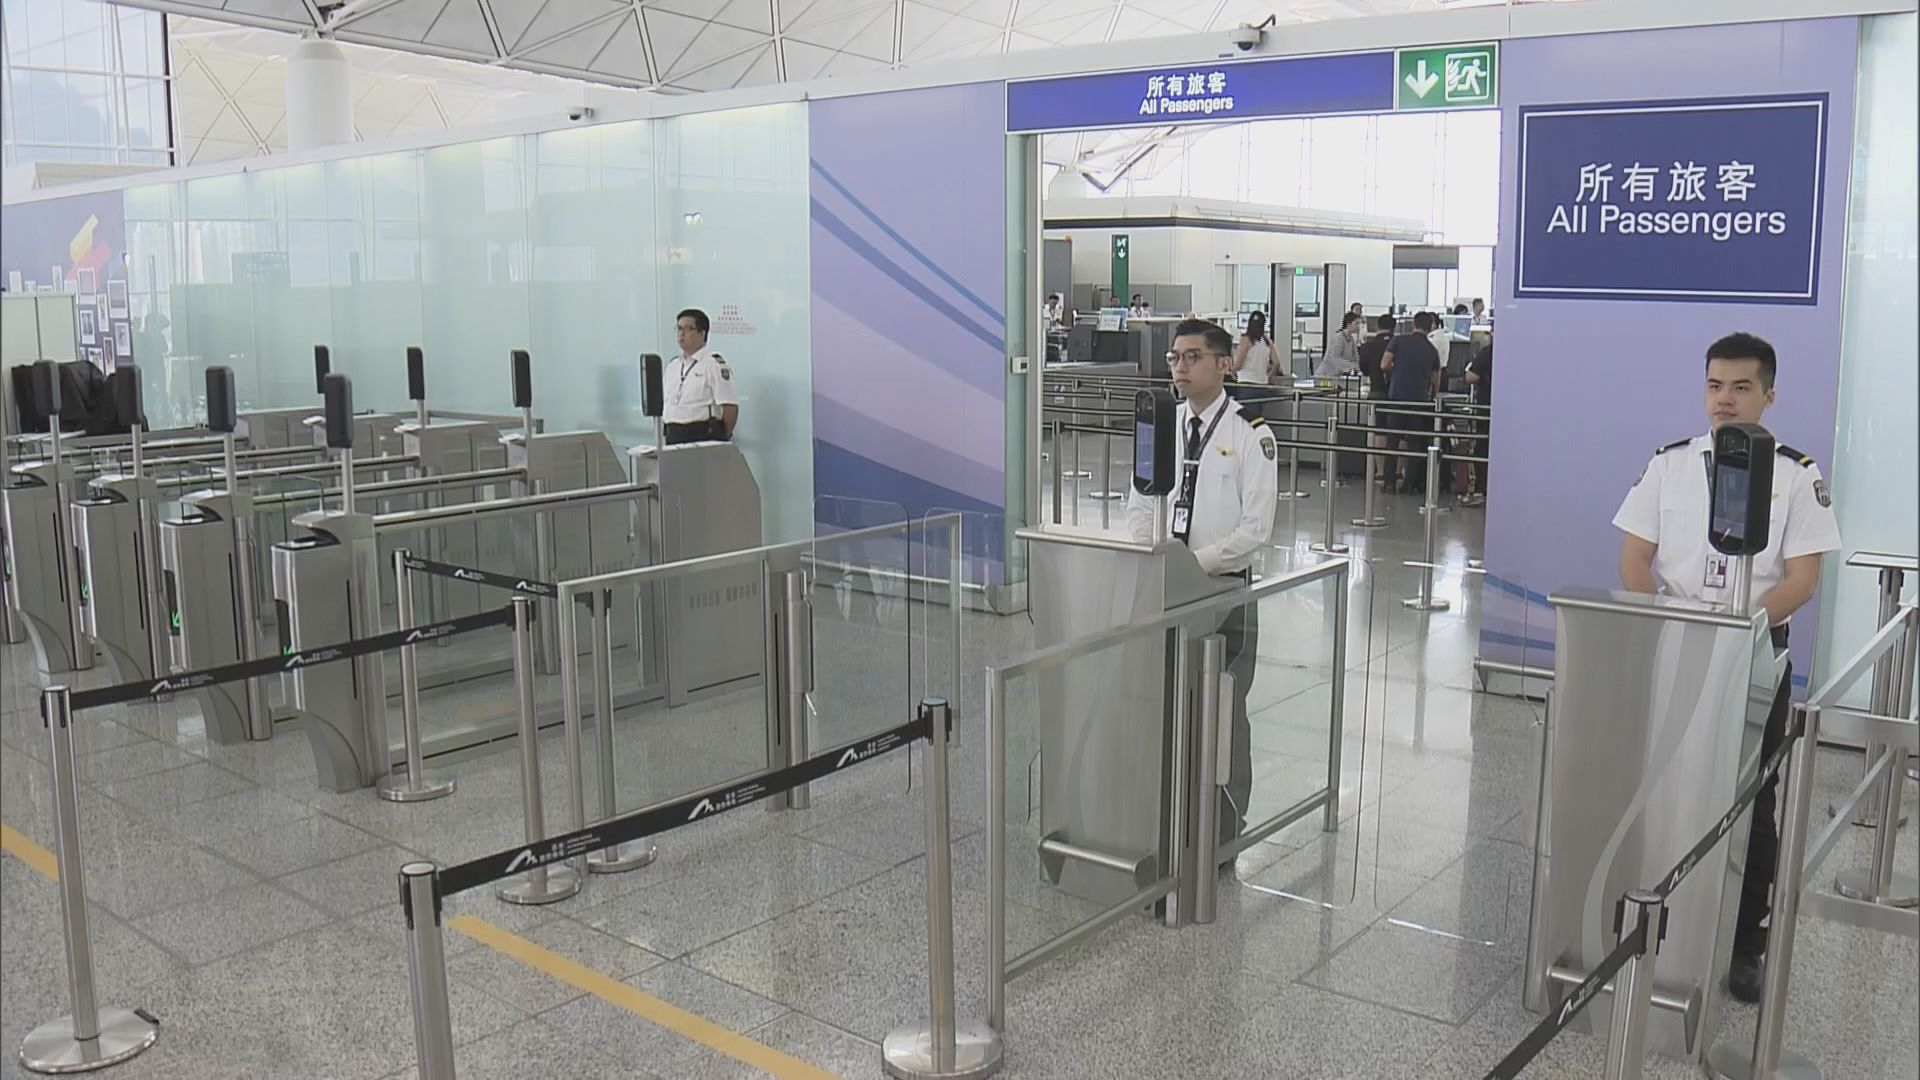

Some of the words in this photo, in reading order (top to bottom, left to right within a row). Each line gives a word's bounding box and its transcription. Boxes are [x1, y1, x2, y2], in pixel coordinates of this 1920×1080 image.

[1146, 71, 1226, 98] 所有旅客
[1139, 98, 1157, 115] All
[1160, 96, 1234, 114] Passengers
[1575, 160, 1757, 203] 所有旅客
[1546, 204, 1588, 233] All
[1599, 204, 1786, 241] Passengers
